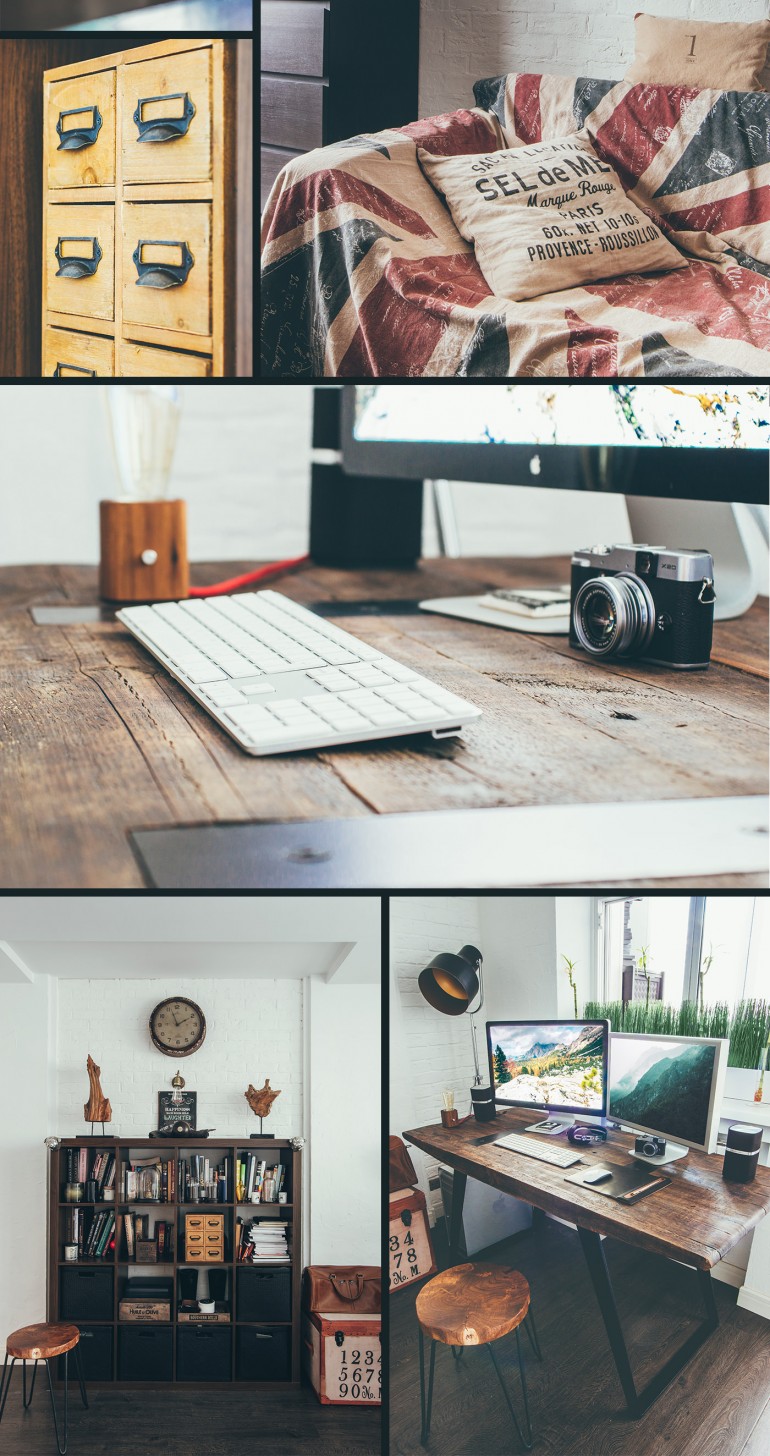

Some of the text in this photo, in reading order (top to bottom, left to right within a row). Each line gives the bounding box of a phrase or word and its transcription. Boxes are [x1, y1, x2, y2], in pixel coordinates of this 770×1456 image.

[684, 34, 697, 57] 1
[471, 154, 499, 174] SAC
[475, 171, 538, 202] SEL
[537, 165, 570, 186] de
[526, 180, 617, 210] Marque Rouge
[559, 202, 604, 220] PARIS
[576, 219, 600, 236] NET
[392, 1264, 421, 1285] No. M.
[361, 1385, 376, 1400] No.
